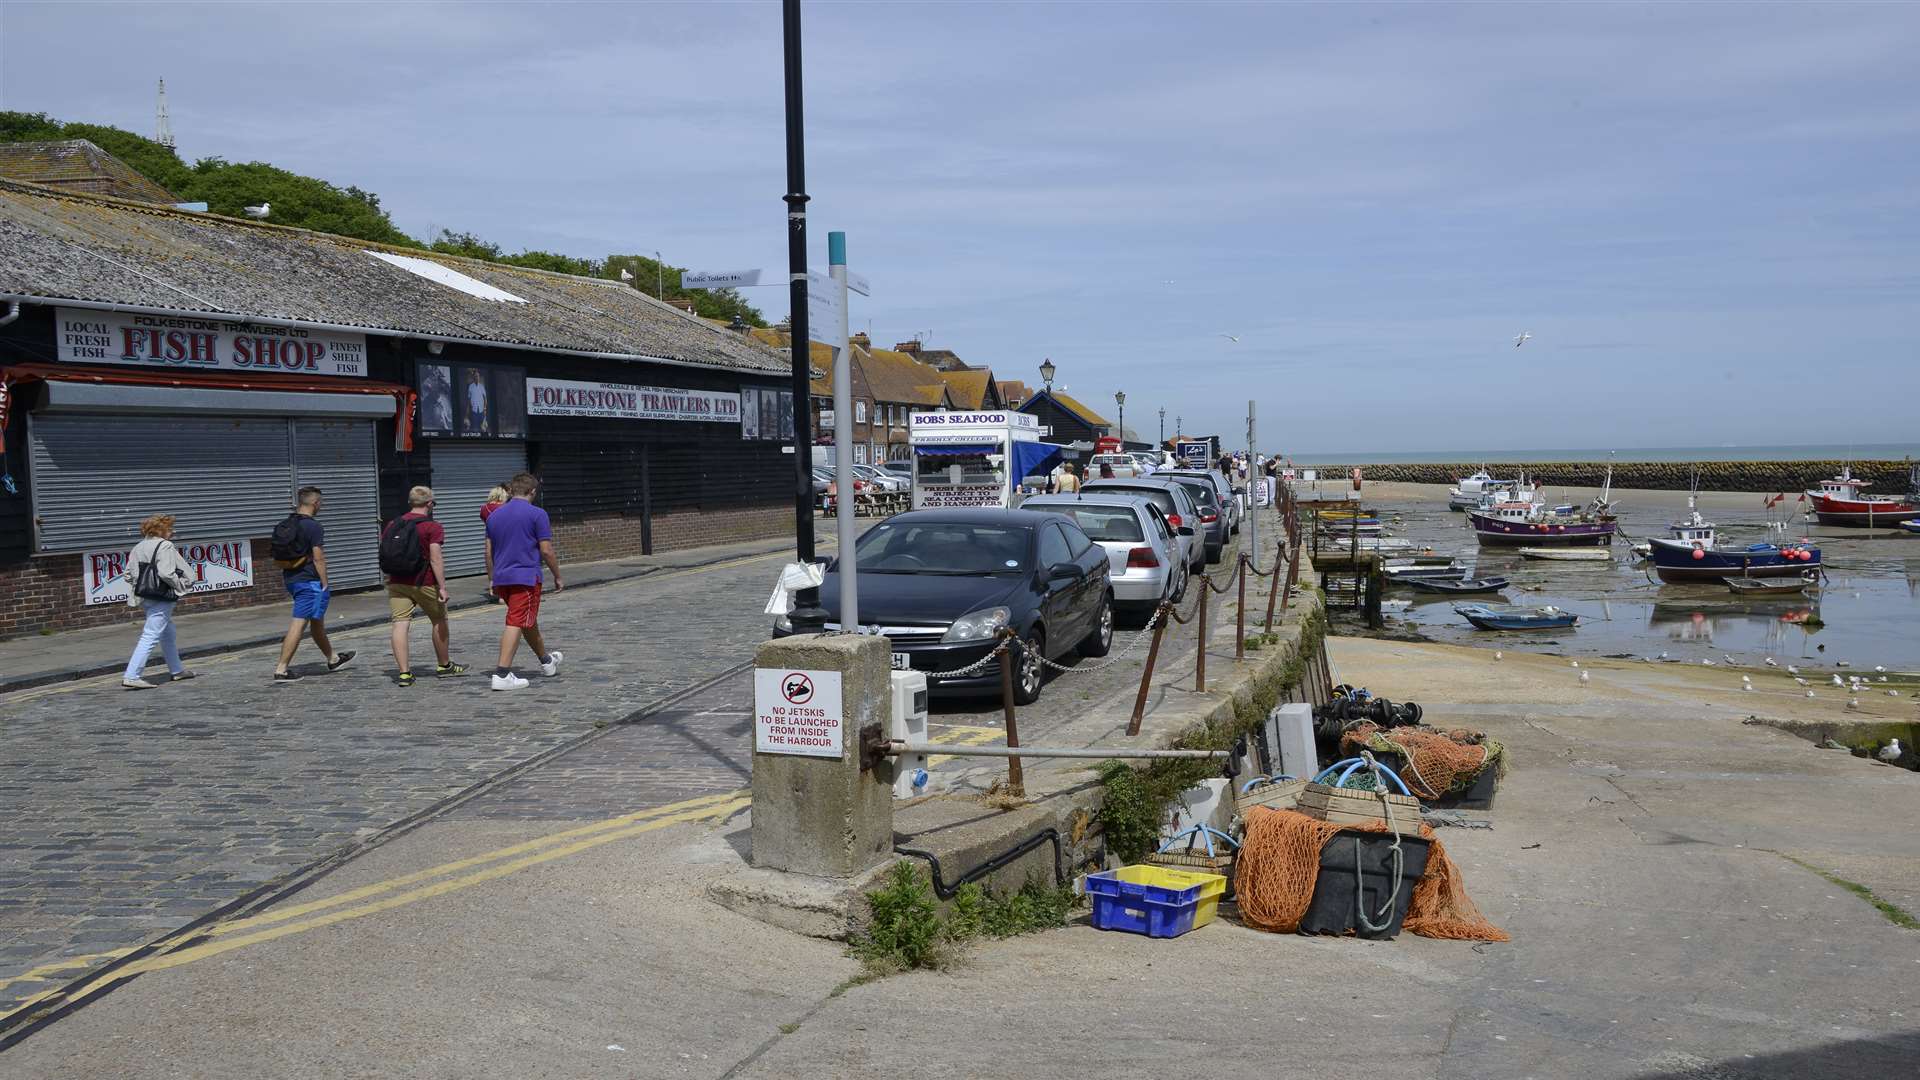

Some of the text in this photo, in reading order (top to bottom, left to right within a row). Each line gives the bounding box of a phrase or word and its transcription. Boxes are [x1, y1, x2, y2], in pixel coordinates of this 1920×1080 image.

[686, 275, 706, 283] Public
[65, 321, 111, 334] LOCAL
[134, 316, 309, 338] FOLKESTONE TRAWLERS LTD
[65, 334, 111, 347] FRESH
[73, 347, 105, 358] FISH
[120, 326, 326, 371] FISH SHOP
[330, 341, 363, 353] FINEST
[331, 353, 362, 363] SHELL
[336, 363, 358, 374] FISH
[533, 386, 737, 415] FOLKESTONE TRAWLERS LTD
[915, 414, 1005, 425] BOBS SEAFOOD
[215, 579, 248, 589] BOATS
[772, 706, 825, 717] NO JETSKIS
[760, 715, 839, 728] TO BE LAUNCHED
[770, 725, 829, 737] FROM INSIDE
[768, 735, 832, 747] THE HARBOUR
